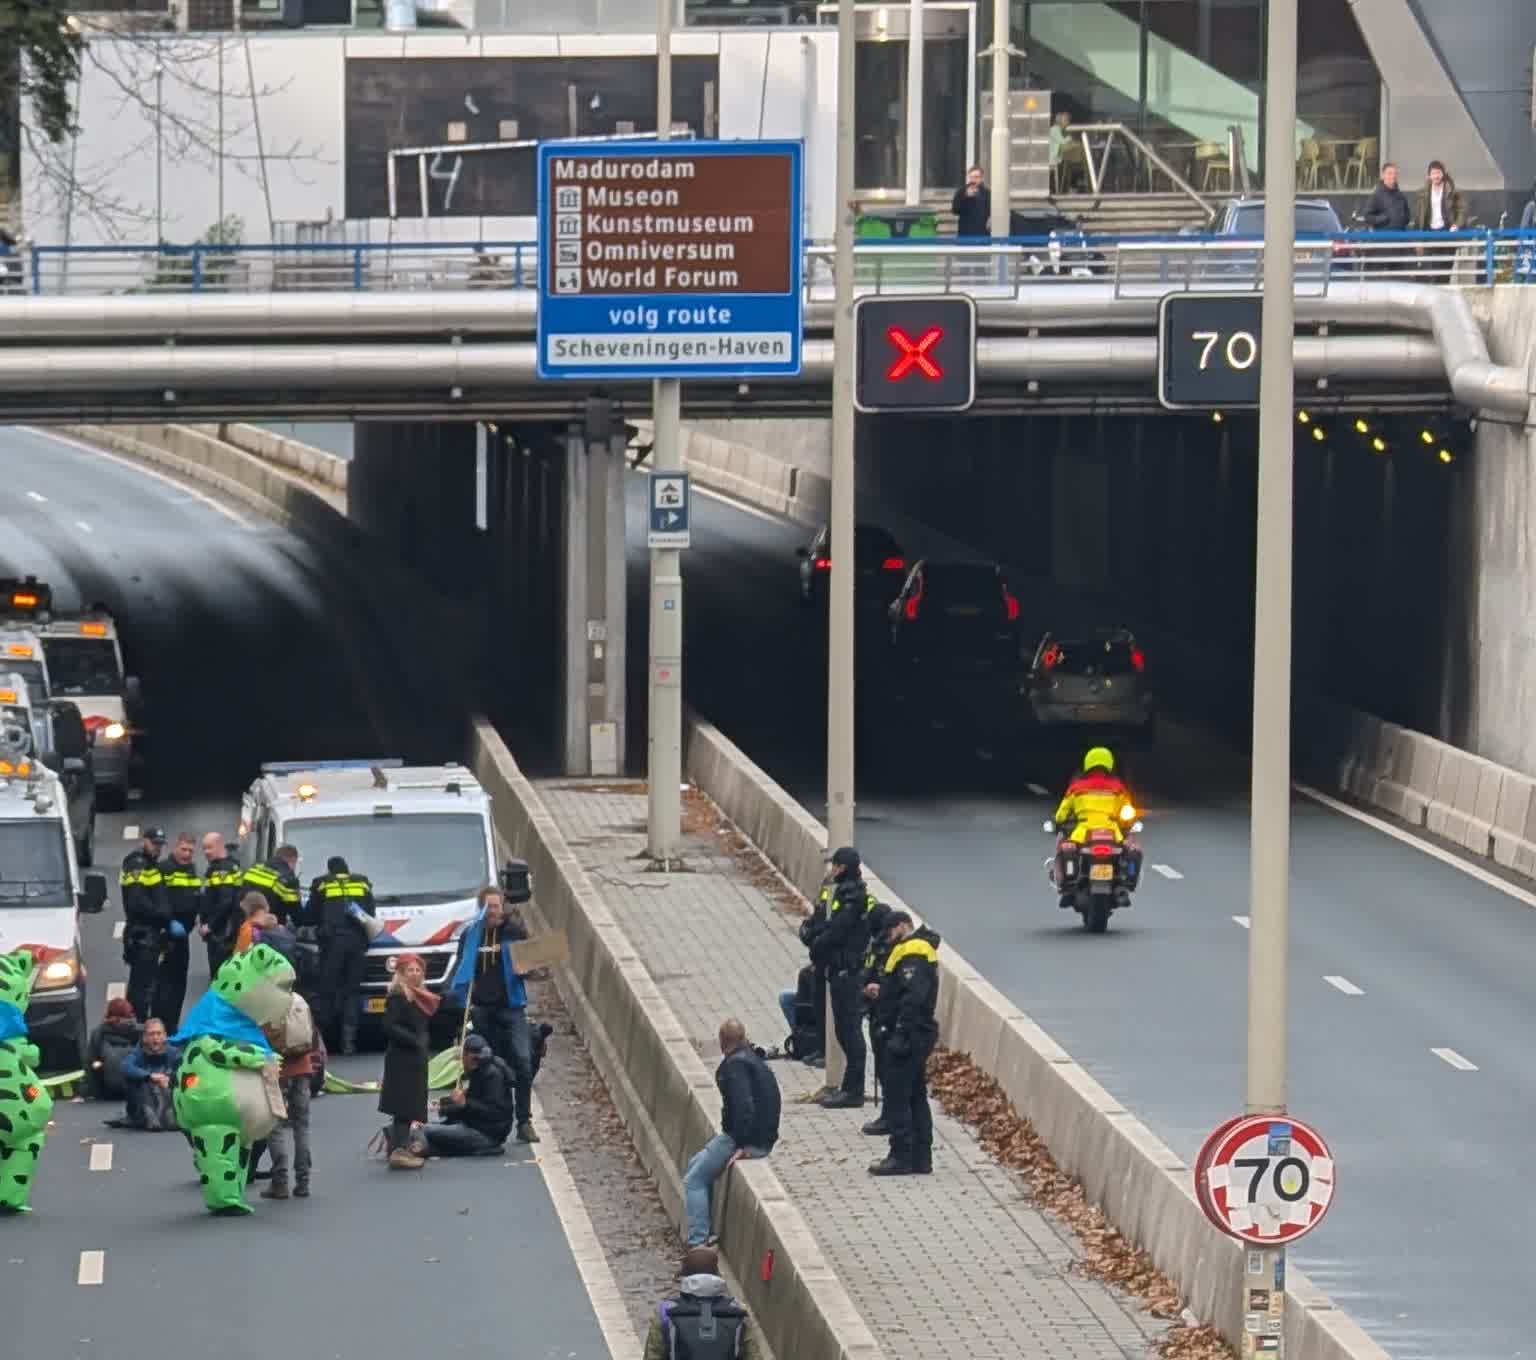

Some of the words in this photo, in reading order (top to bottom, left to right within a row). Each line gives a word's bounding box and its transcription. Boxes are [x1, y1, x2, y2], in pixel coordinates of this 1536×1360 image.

[555, 160, 695, 179] Madurodam
[587, 186, 679, 206] Museon
[586, 214, 754, 233] Kunstmuseum
[586, 240, 735, 260] Omniversum
[586, 267, 656, 288] World
[665, 267, 739, 287] Forum
[609, 305, 659, 329] volg
[667, 305, 732, 324] route
[554, 337, 785, 360] Scheveningen-Haven
[1192, 331, 1256, 369] 70
[1234, 1157, 1310, 1203] 70
